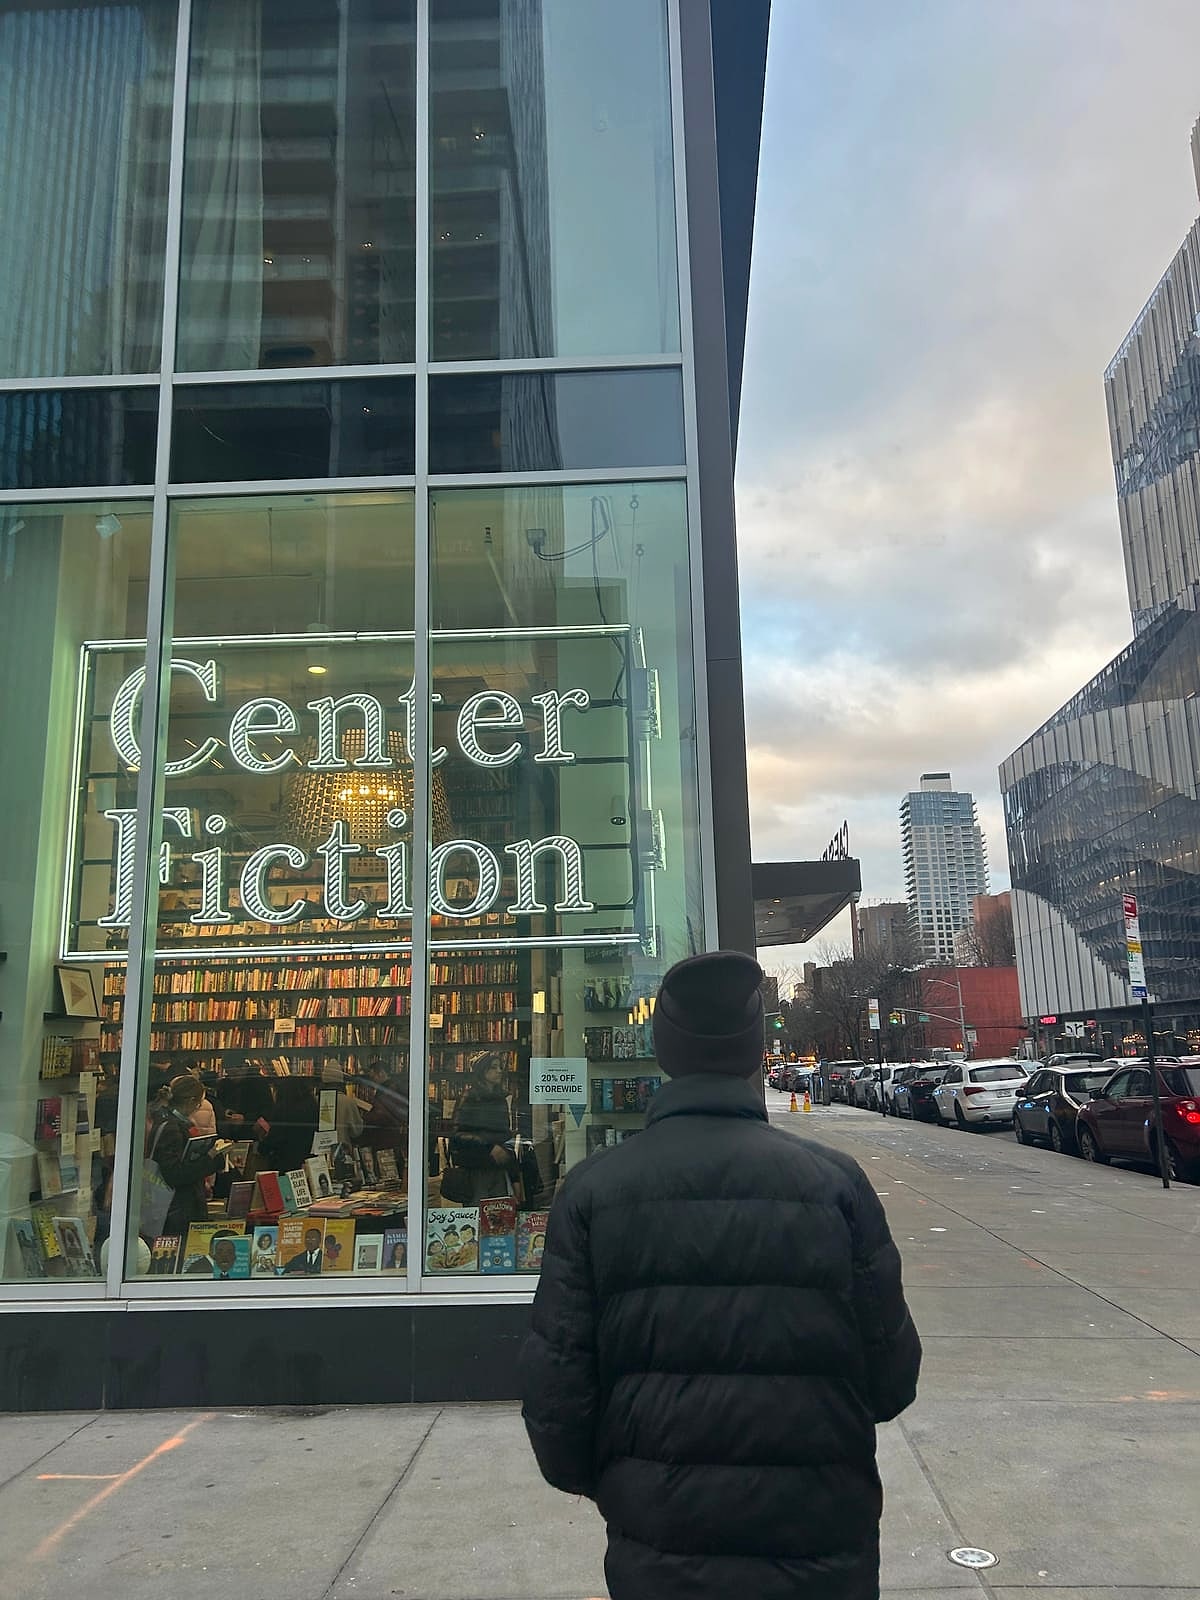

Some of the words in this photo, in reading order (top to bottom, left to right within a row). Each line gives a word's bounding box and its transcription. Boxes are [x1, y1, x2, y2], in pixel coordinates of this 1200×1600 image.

[111, 658, 590, 775] Center
[98, 807, 595, 927] Fiction
[541, 1074, 558, 1082] 20%
[559, 1074, 576, 1082] OFF
[534, 1085, 583, 1093] STOREWIDE
[428, 1211, 447, 1223] Soy
[447, 1210, 477, 1223] Sauce!
[155, 1240, 179, 1248] FIRE
